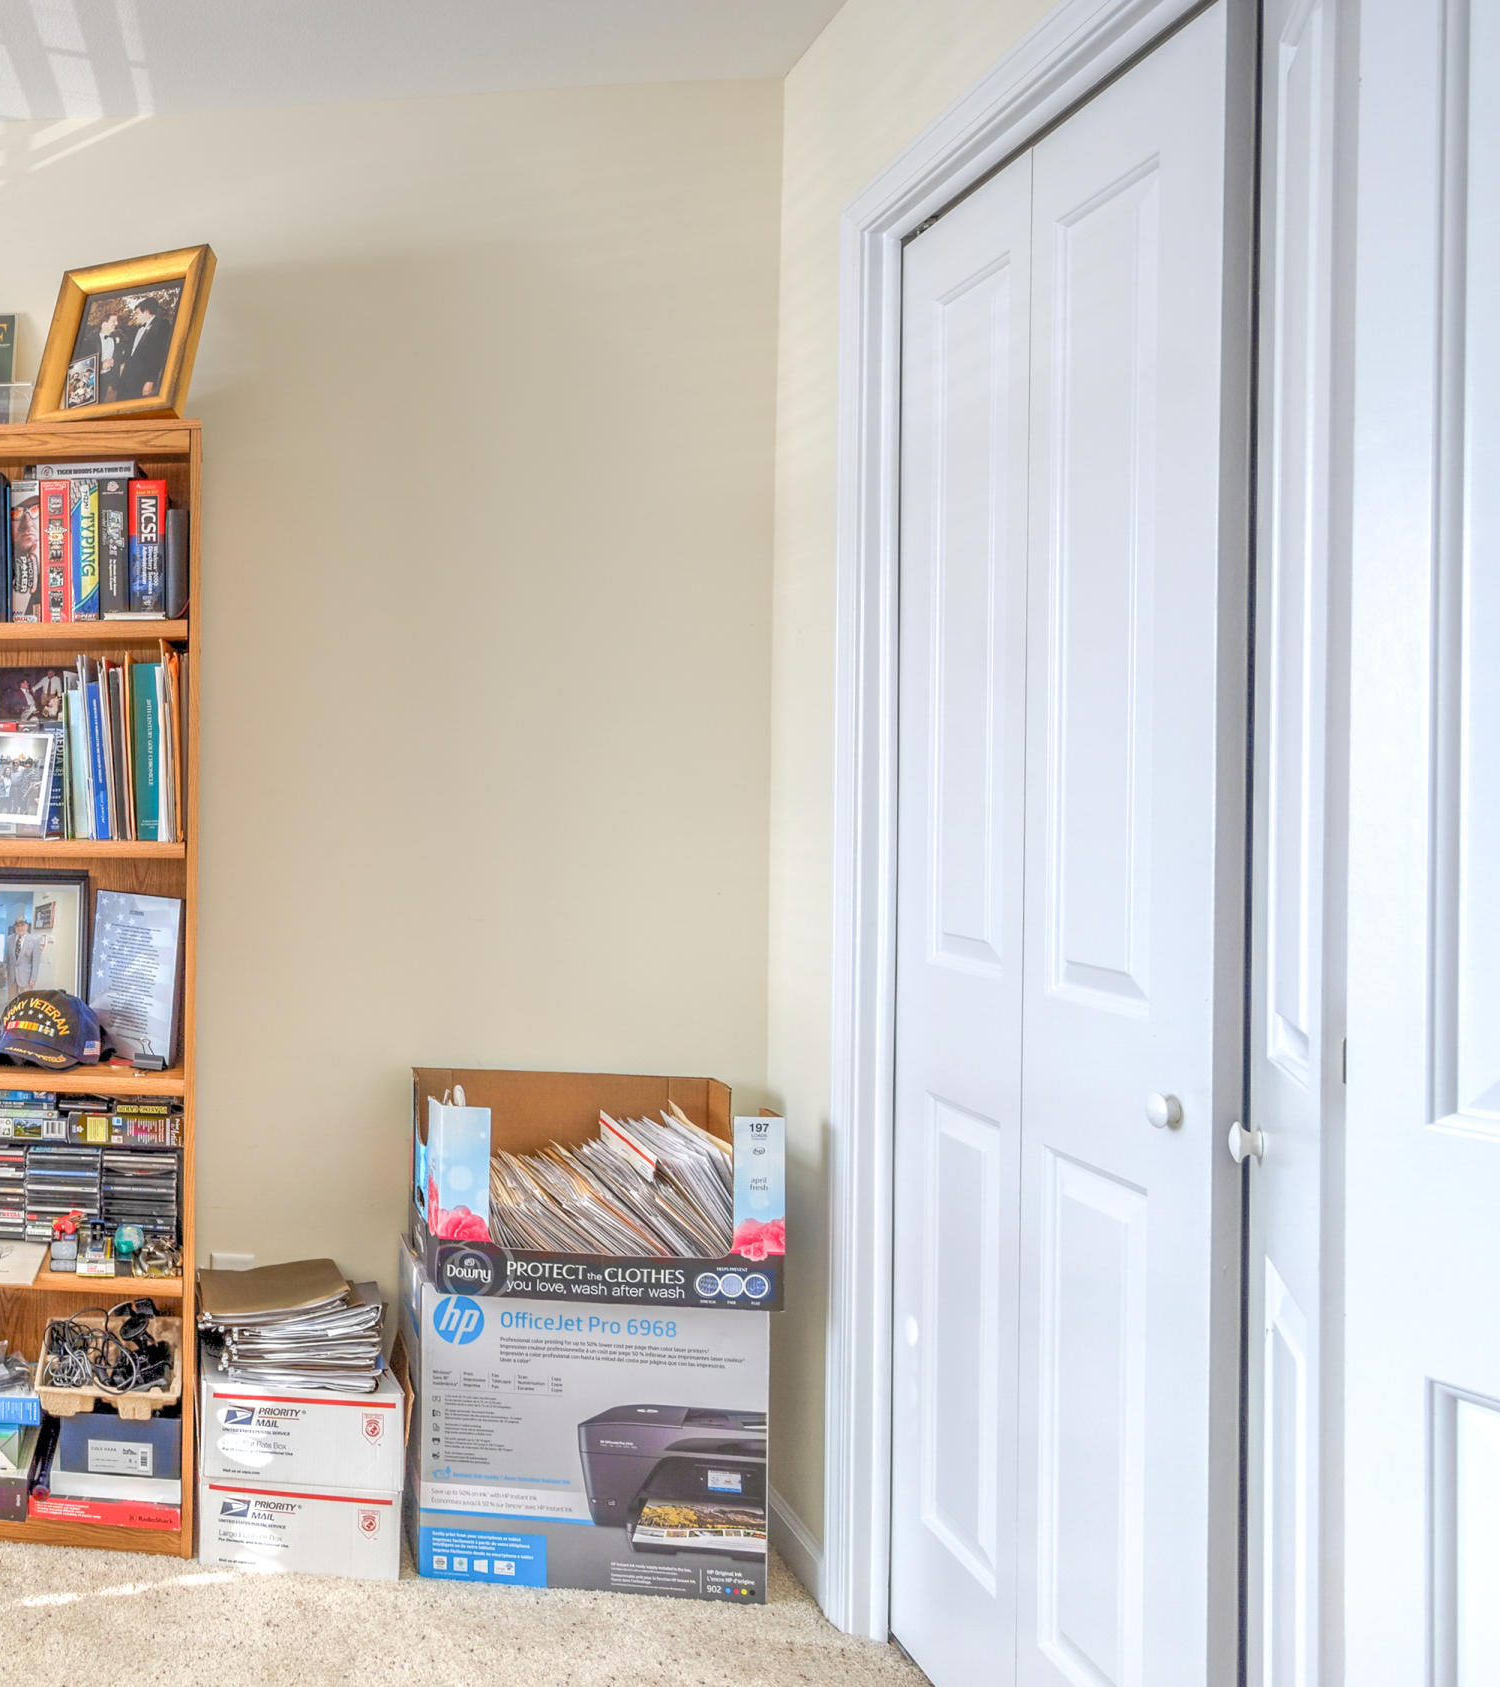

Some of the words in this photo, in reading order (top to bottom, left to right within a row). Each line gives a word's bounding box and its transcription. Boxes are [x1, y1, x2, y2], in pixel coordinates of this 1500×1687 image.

[141, 498, 156, 543] MCSE
[81, 512, 95, 577] TYPING
[55, 728, 64, 765] MEDIA
[3, 999, 28, 1026] ARMY
[29, 998, 70, 1037] VETERAN
[139, 1106, 168, 1114] PLAYING
[749, 1123, 770, 1133] 197
[750, 1177, 768, 1186] april
[749, 1183, 769, 1191] fresh
[446, 1263, 492, 1283] Downy
[507, 1261, 585, 1280] PROTECT
[587, 1271, 602, 1281] the
[604, 1267, 685, 1285] CLOTHES
[507, 1281, 532, 1294] you
[536, 1278, 567, 1296] love,
[571, 1281, 607, 1295] wash
[612, 1284, 644, 1297] after
[649, 1285, 685, 1299] wash
[438, 1296, 481, 1345] hp
[500, 1310, 583, 1333] OfficeJet
[589, 1315, 621, 1335] Pro
[628, 1318, 678, 1338] 6968
[258, 1407, 301, 1417] PRIORITY
[256, 1419, 280, 1428] MAIL
[257, 1441, 272, 1449] Rate
[273, 1442, 287, 1450] Box
[459, 1489, 472, 1497] 50%
[254, 1500, 297, 1511] PRIORITY
[138, 1516, 173, 1524] RadioShack
[251, 1512, 275, 1521] MAIL
[218, 1529, 237, 1539] Large
[733, 1578, 755, 1586] d'origine
[706, 1585, 722, 1594] 902
